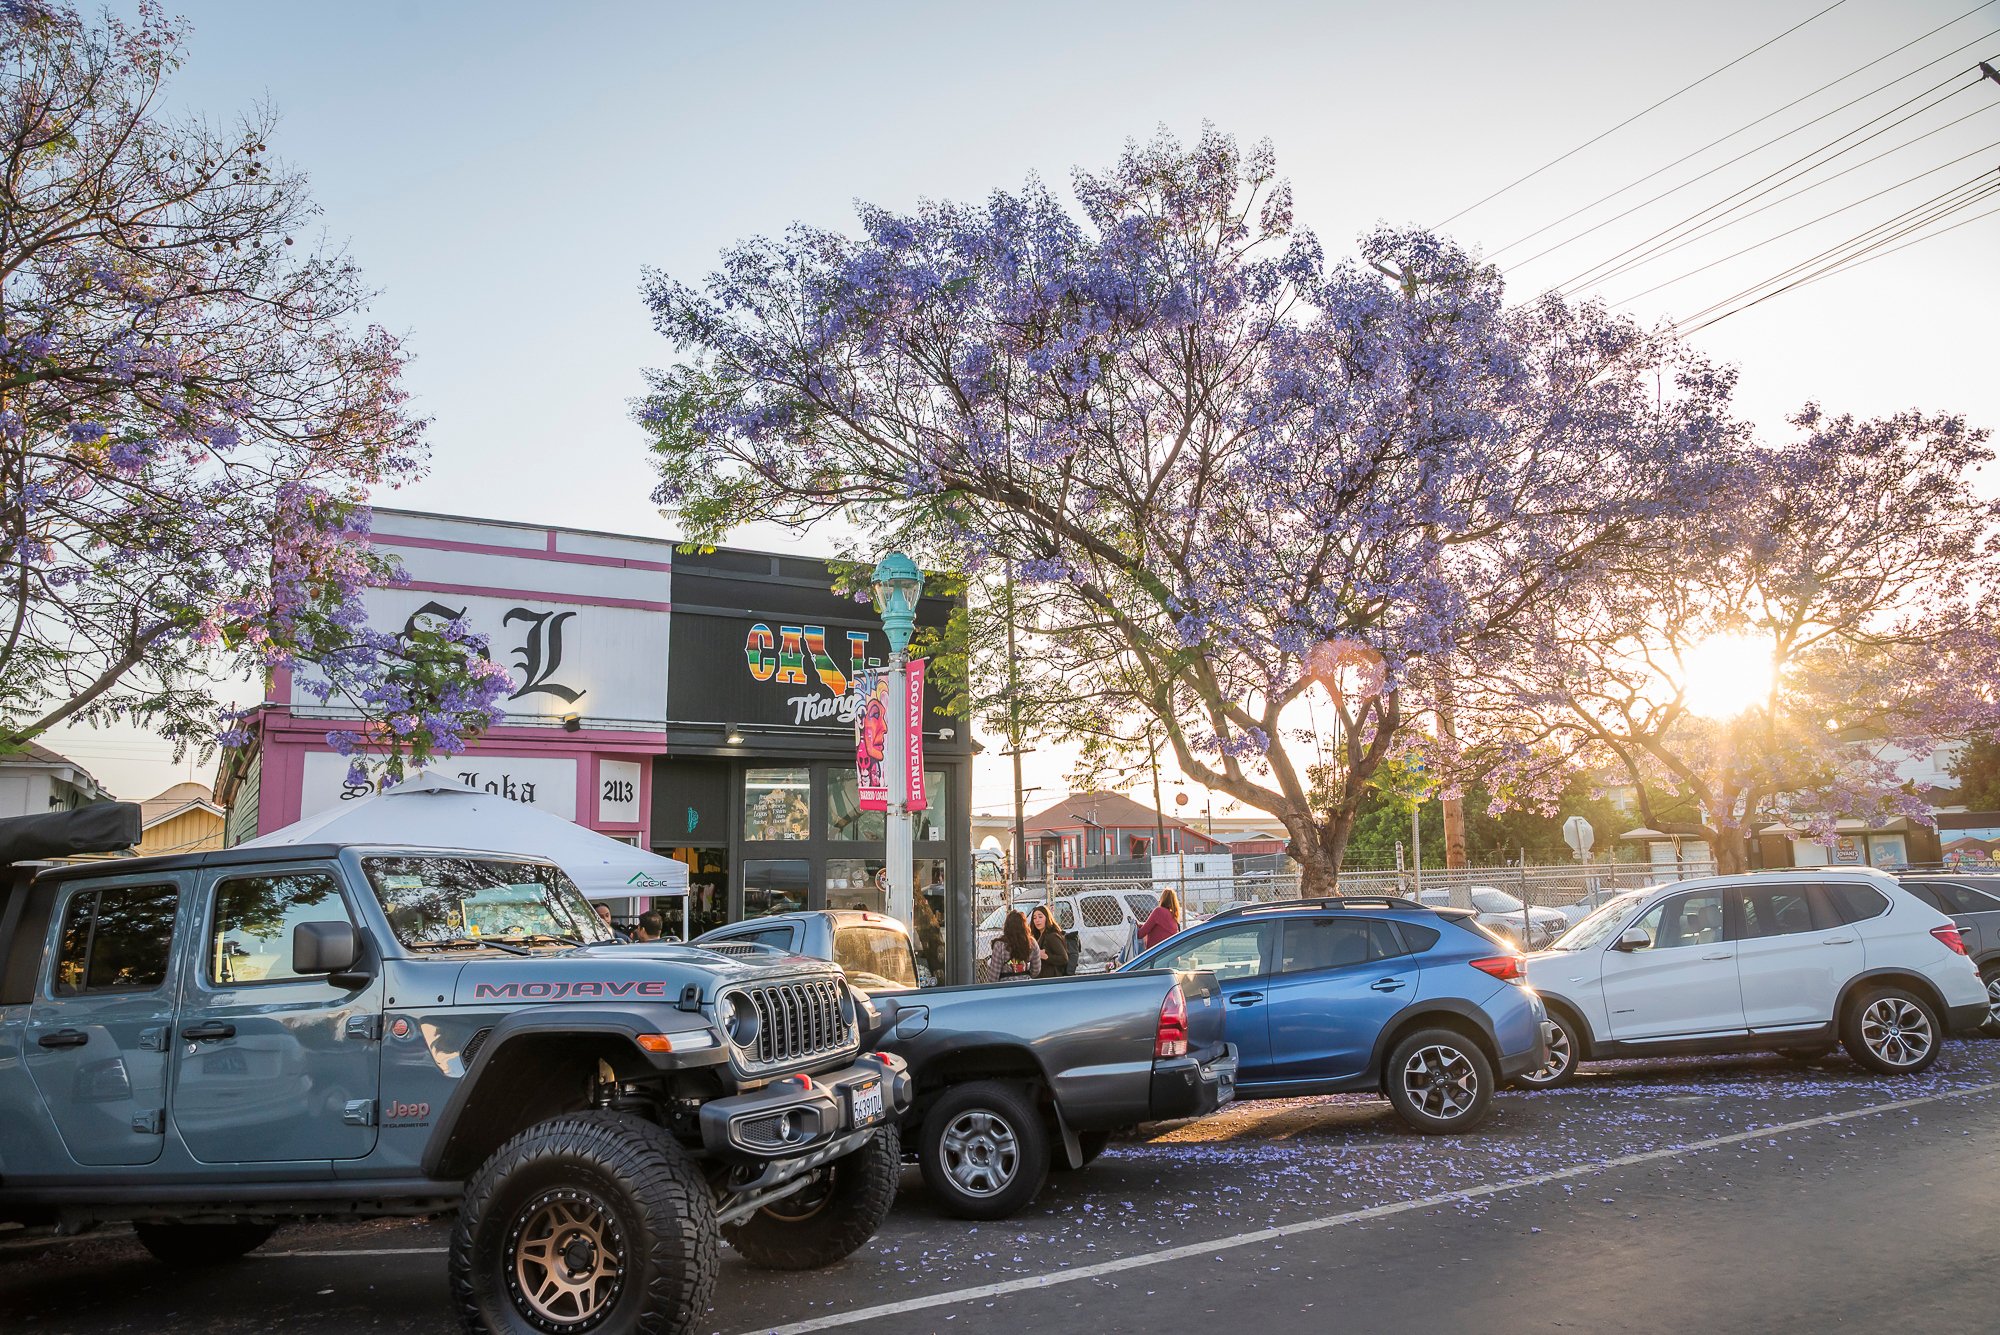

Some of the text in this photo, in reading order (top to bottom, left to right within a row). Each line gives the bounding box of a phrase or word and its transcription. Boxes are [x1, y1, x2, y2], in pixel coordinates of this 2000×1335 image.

[910, 670, 921, 801] LOGAN AVENUE
[602, 780, 634, 803] 2113
[474, 981, 666, 1000] MOJAVE
[386, 1100, 431, 1120] Jeep
